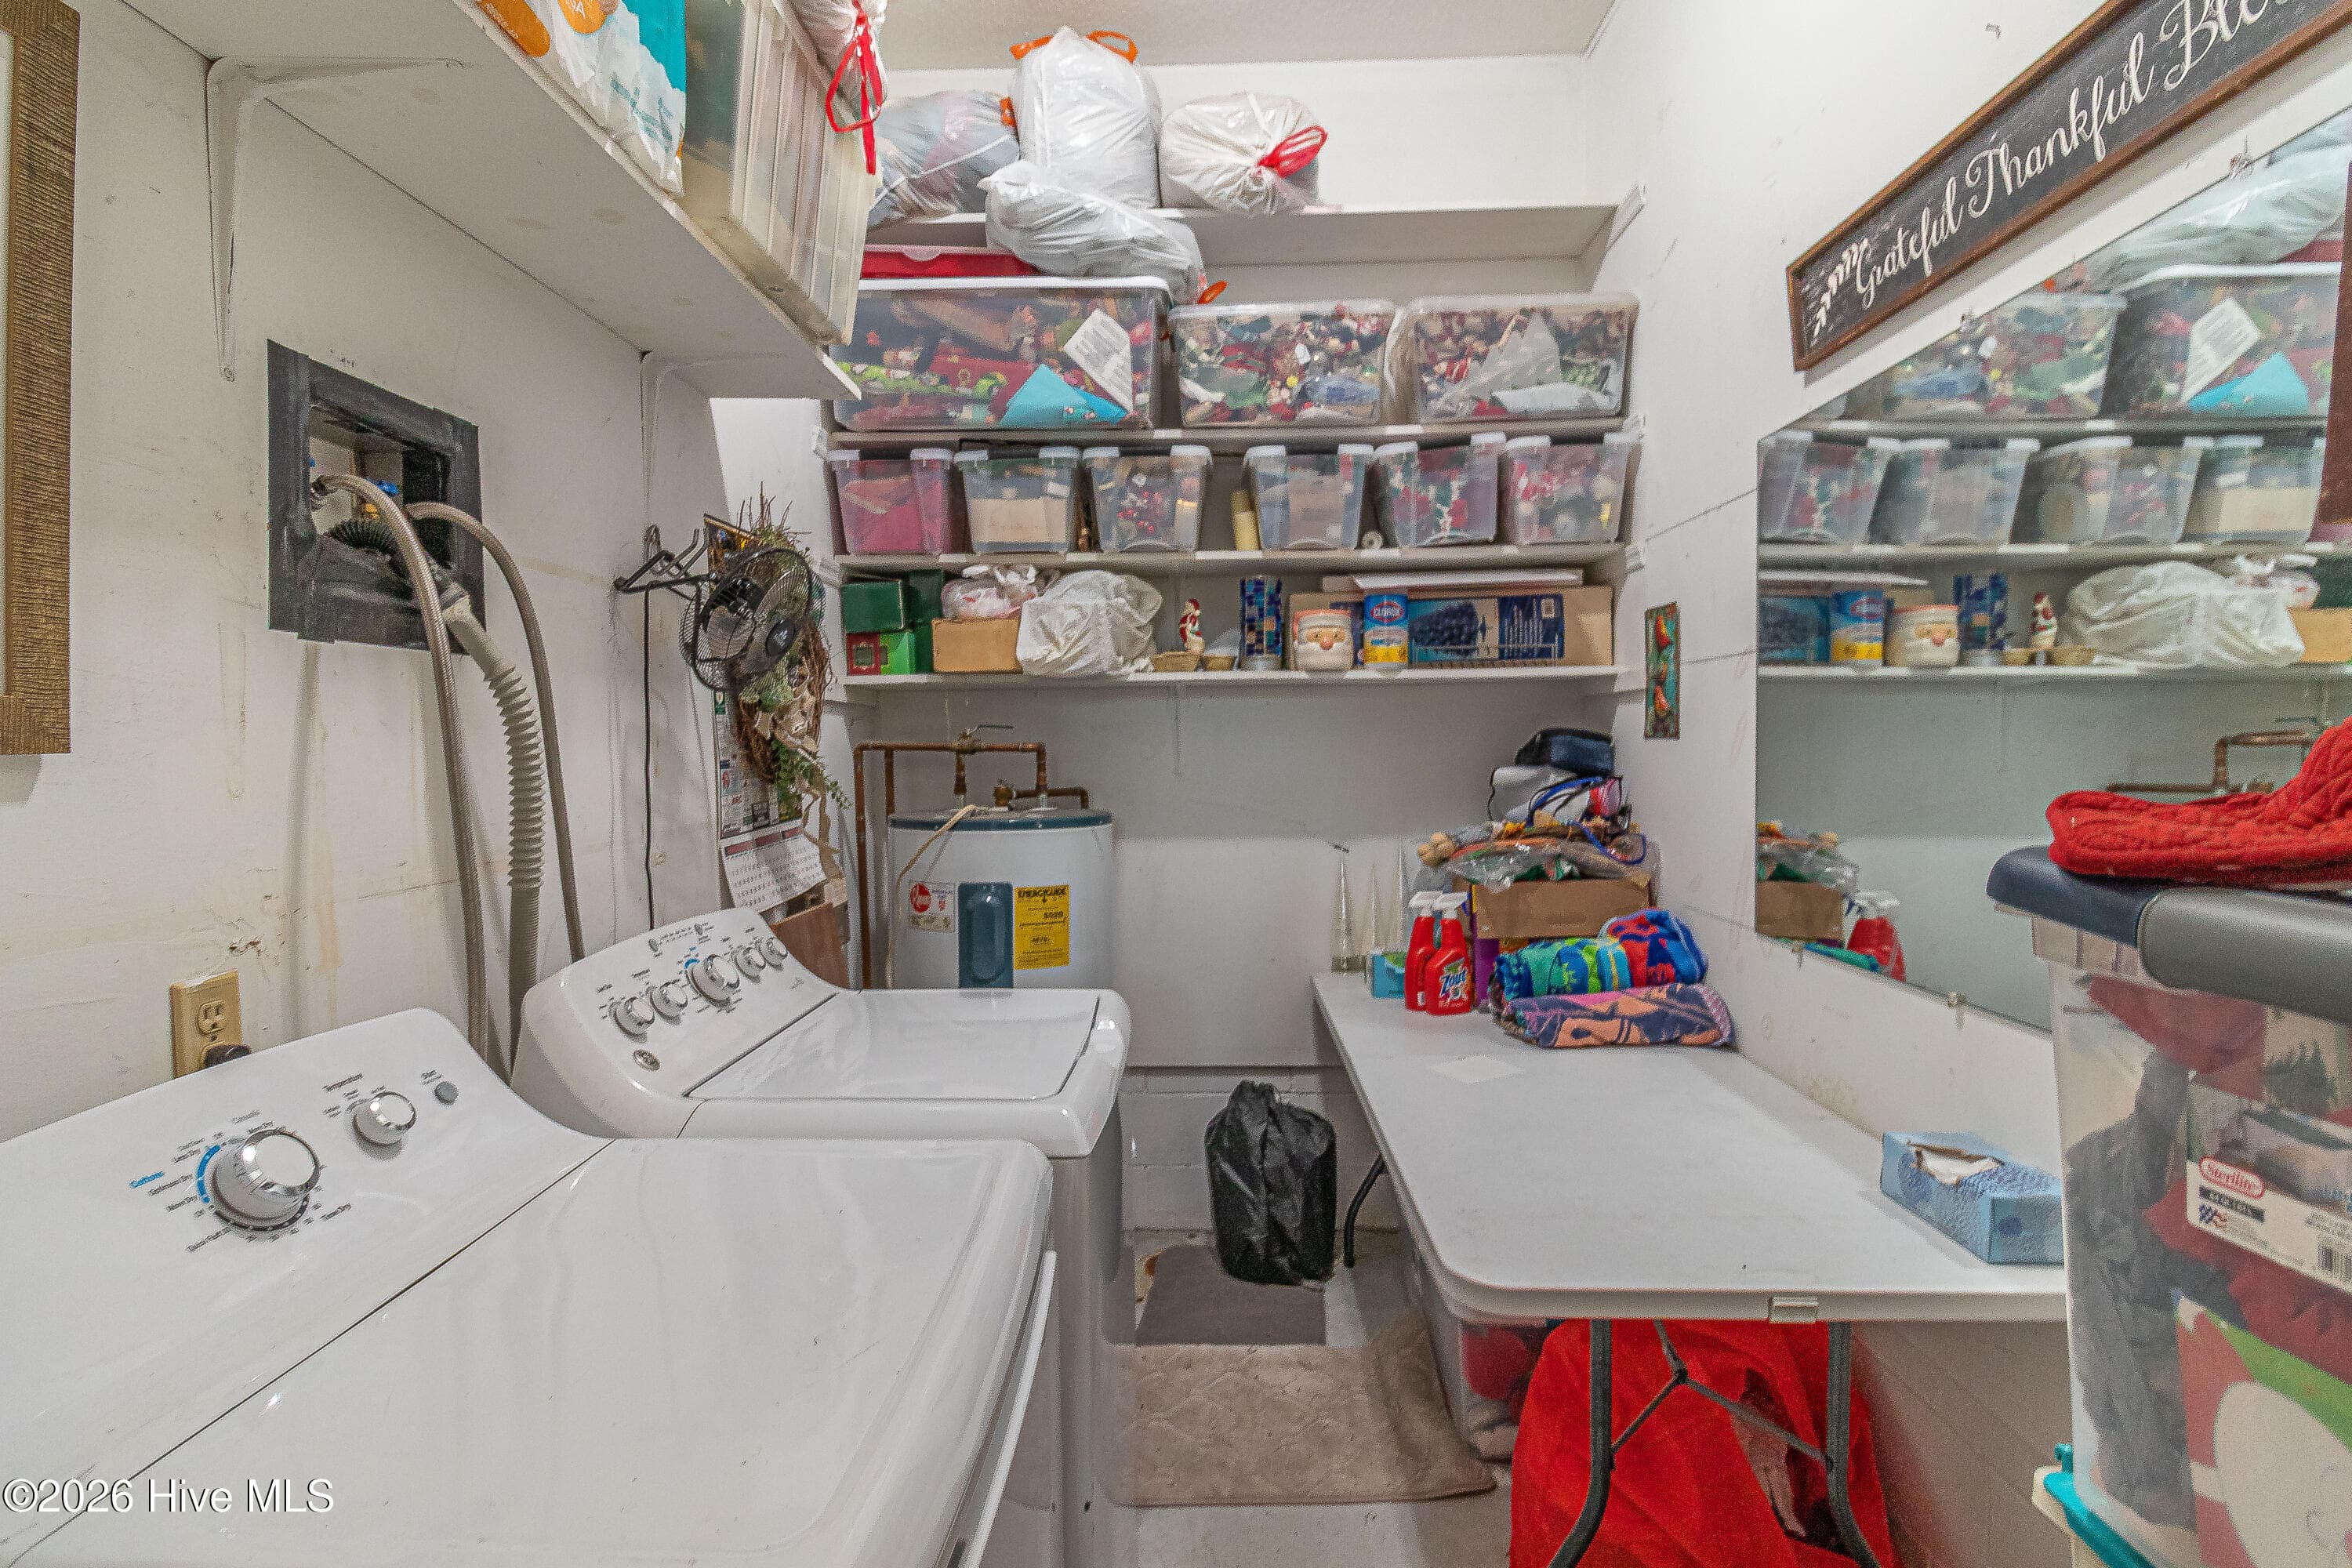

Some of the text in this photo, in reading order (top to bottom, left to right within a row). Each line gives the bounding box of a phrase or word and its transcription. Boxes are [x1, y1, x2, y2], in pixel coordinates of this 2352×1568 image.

[1855, 176, 1965, 310] Grateful
[1965, 31, 2154, 219] Thankful
[2205, 1163, 2253, 1192] Sterilite
